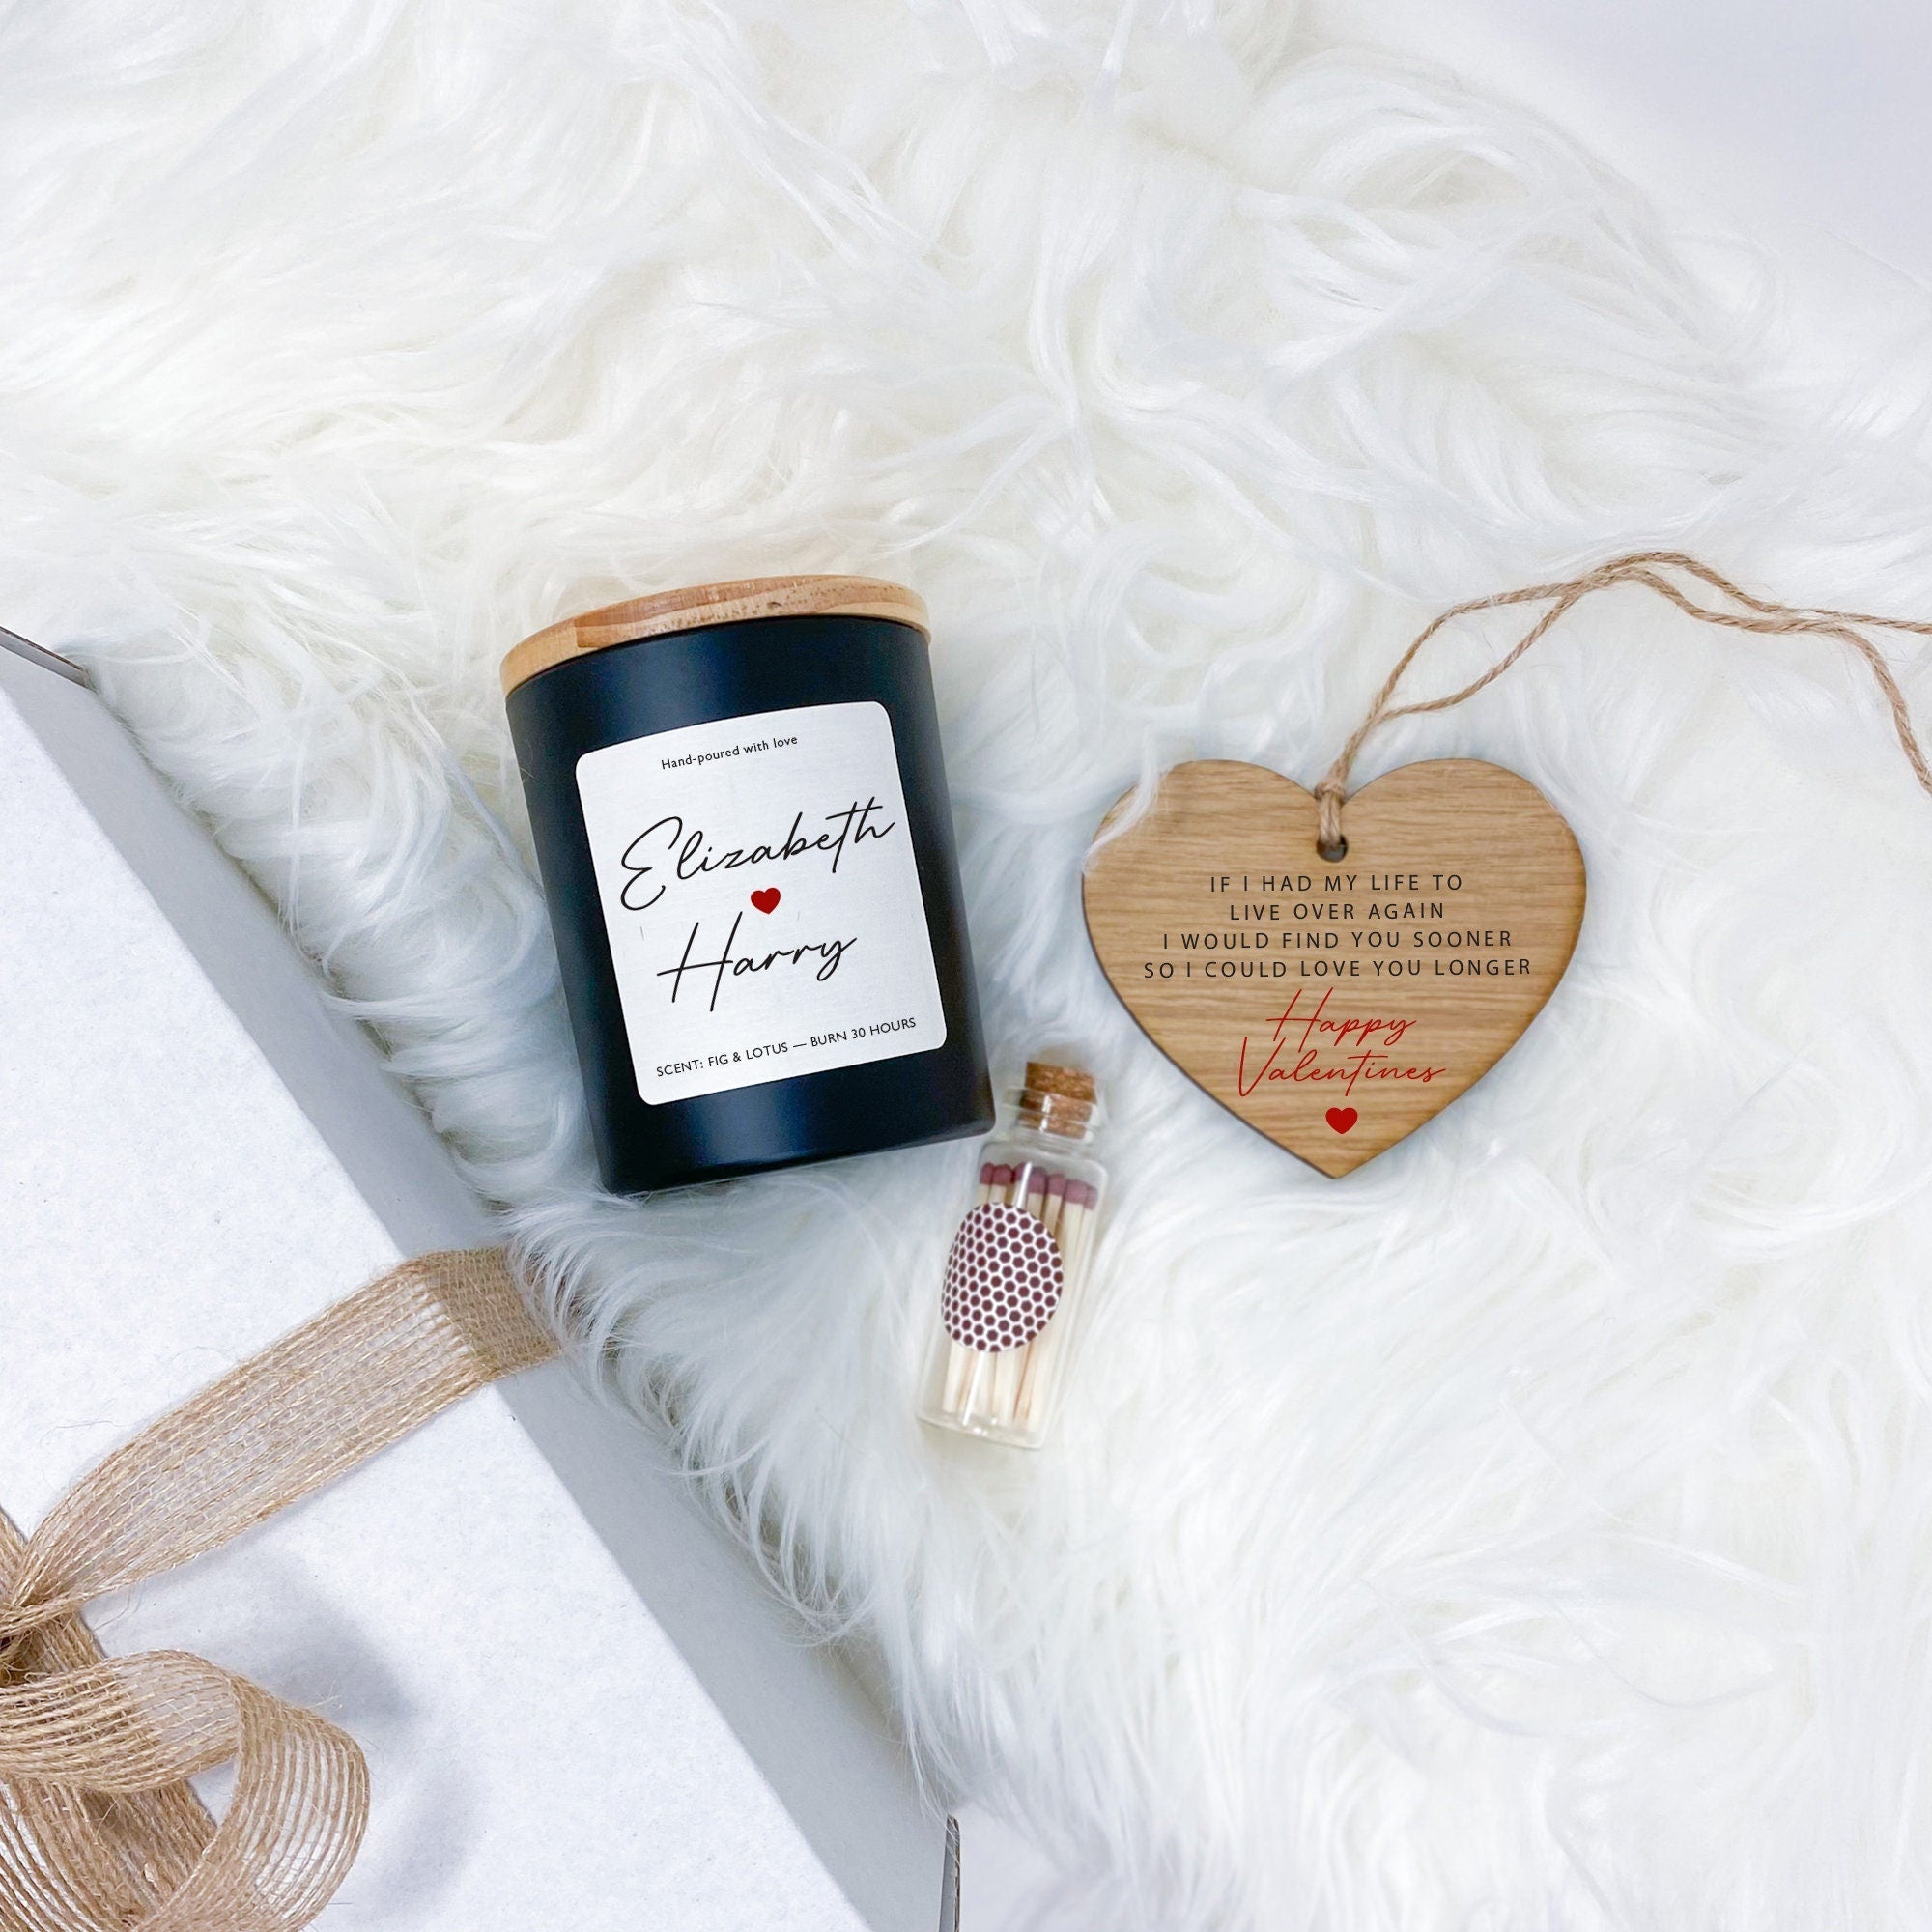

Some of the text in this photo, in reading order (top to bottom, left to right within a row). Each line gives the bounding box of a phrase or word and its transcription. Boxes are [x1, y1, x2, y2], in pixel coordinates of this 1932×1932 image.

[661, 735, 797, 770] Hand-poured with love
[620, 797, 895, 910] Elizabeth
[1210, 874, 1463, 893] IF I HAD MY LIFE TO
[1230, 902, 1444, 921] LIVE OVER AGAIN
[657, 911, 857, 1012] Harry
[1163, 930, 1512, 950] I WOULD FIND YOU SOONER
[1144, 959, 1530, 979] SO I COULD LOVE YOU LONGER
[1266, 987, 1417, 1053] Happy
[657, 1060, 704, 1077] SCENT:
[708, 1054, 729, 1067] FIG
[733, 1052, 741, 1062] &
[746, 1042, 788, 1060] LOTUS
[810, 1031, 847, 1047] BURN
[851, 1027, 866, 1039] 30
[869, 1017, 916, 1037] HOURS
[1238, 1037, 1445, 1097] Valentines
